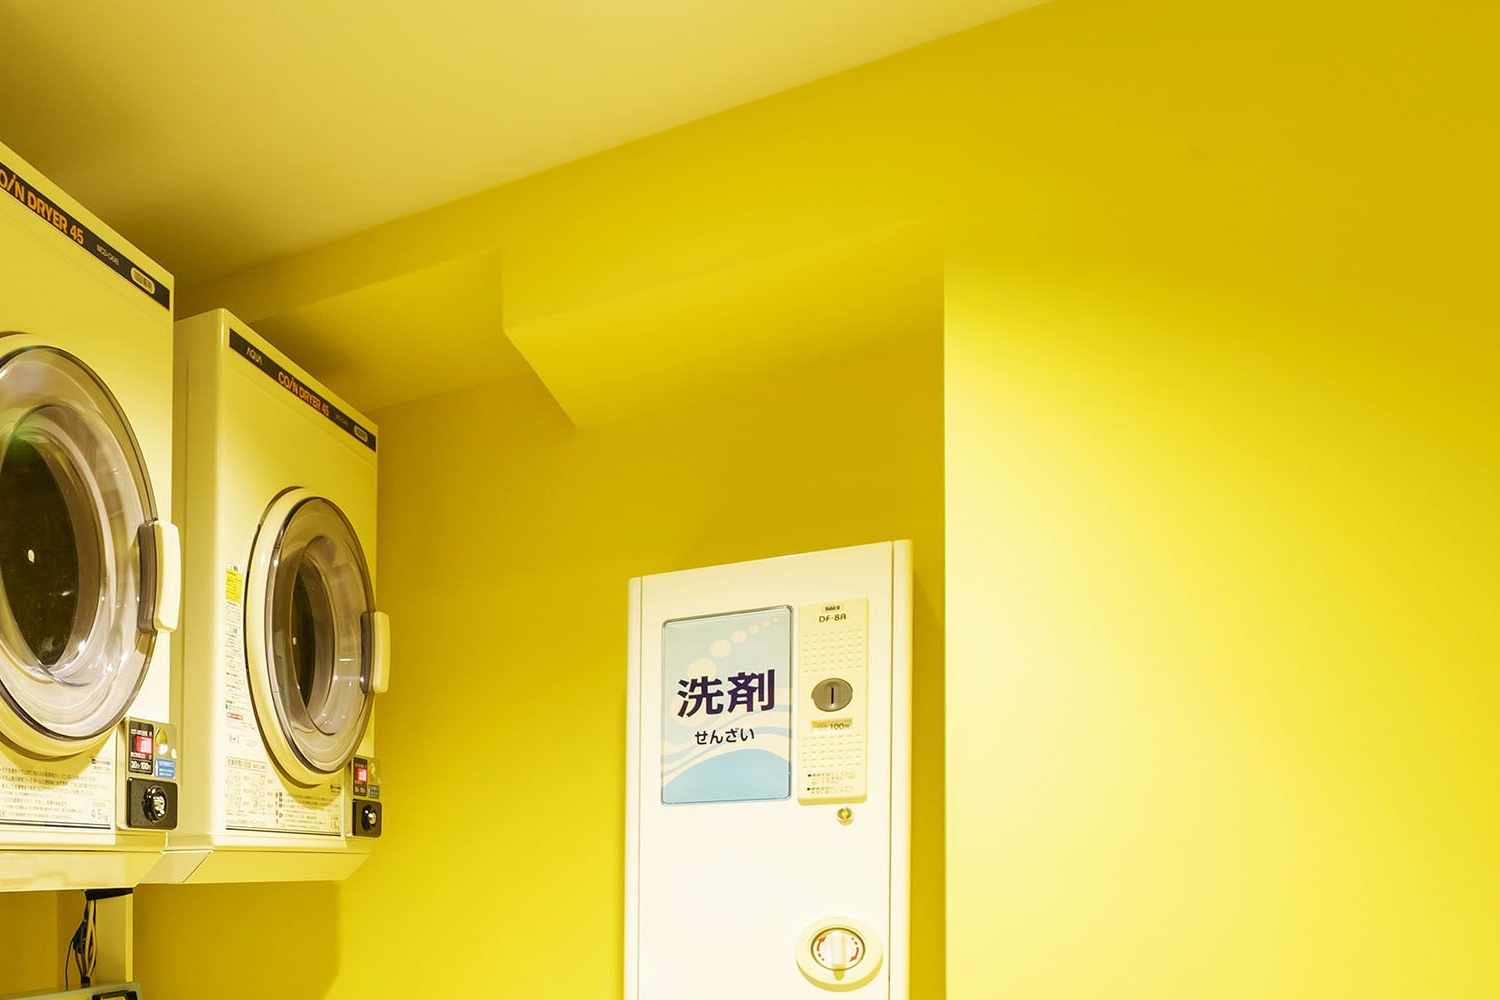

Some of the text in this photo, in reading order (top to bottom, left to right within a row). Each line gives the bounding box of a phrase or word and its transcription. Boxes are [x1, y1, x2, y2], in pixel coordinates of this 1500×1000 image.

[27, 191, 68, 234] DRYER
[69, 224, 85, 246] 45
[676, 668, 776, 719] 洗剤
[694, 727, 755, 746] せんざい
